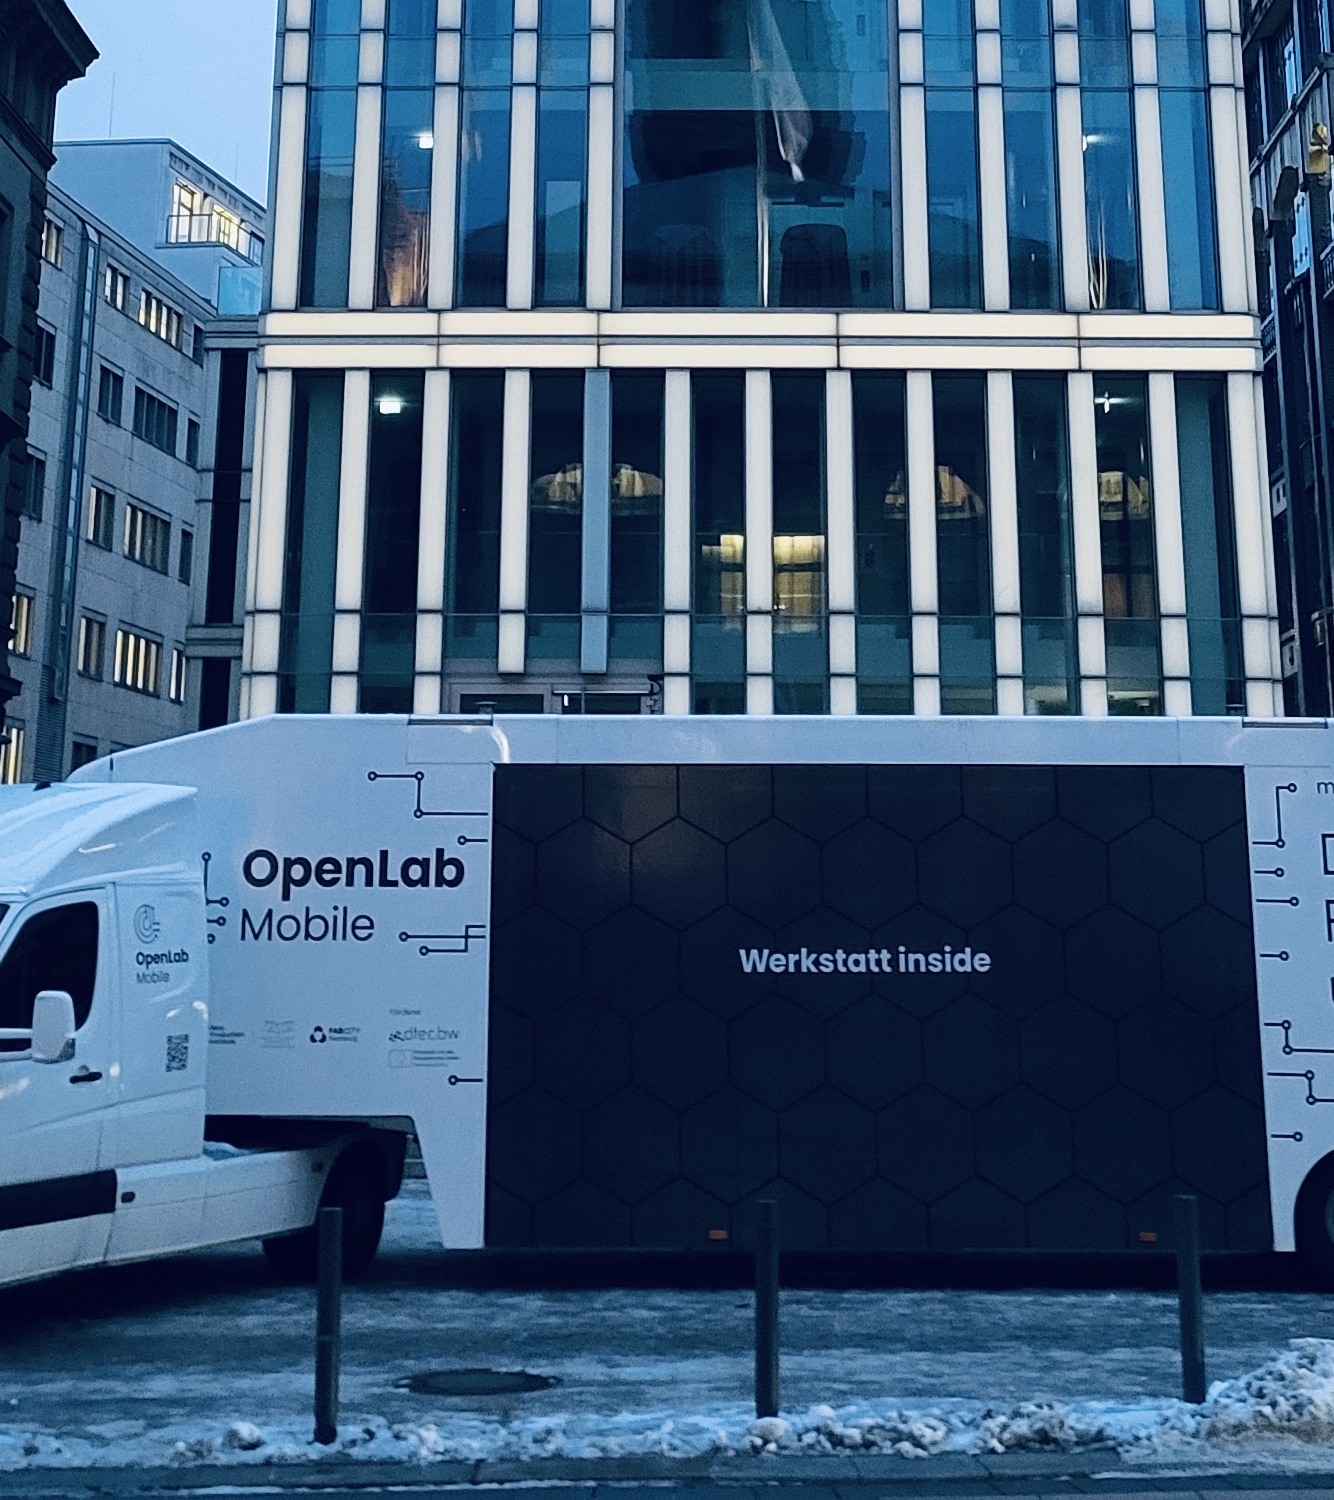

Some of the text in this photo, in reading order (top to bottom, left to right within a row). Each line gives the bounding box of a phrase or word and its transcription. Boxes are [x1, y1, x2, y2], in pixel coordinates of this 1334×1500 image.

[242, 847, 465, 902] OpenLab
[240, 905, 375, 942] Mobile
[135, 948, 190, 971] OpenLab
[738, 945, 992, 973] Werkstatt inside
[136, 971, 170, 985] Mobile
